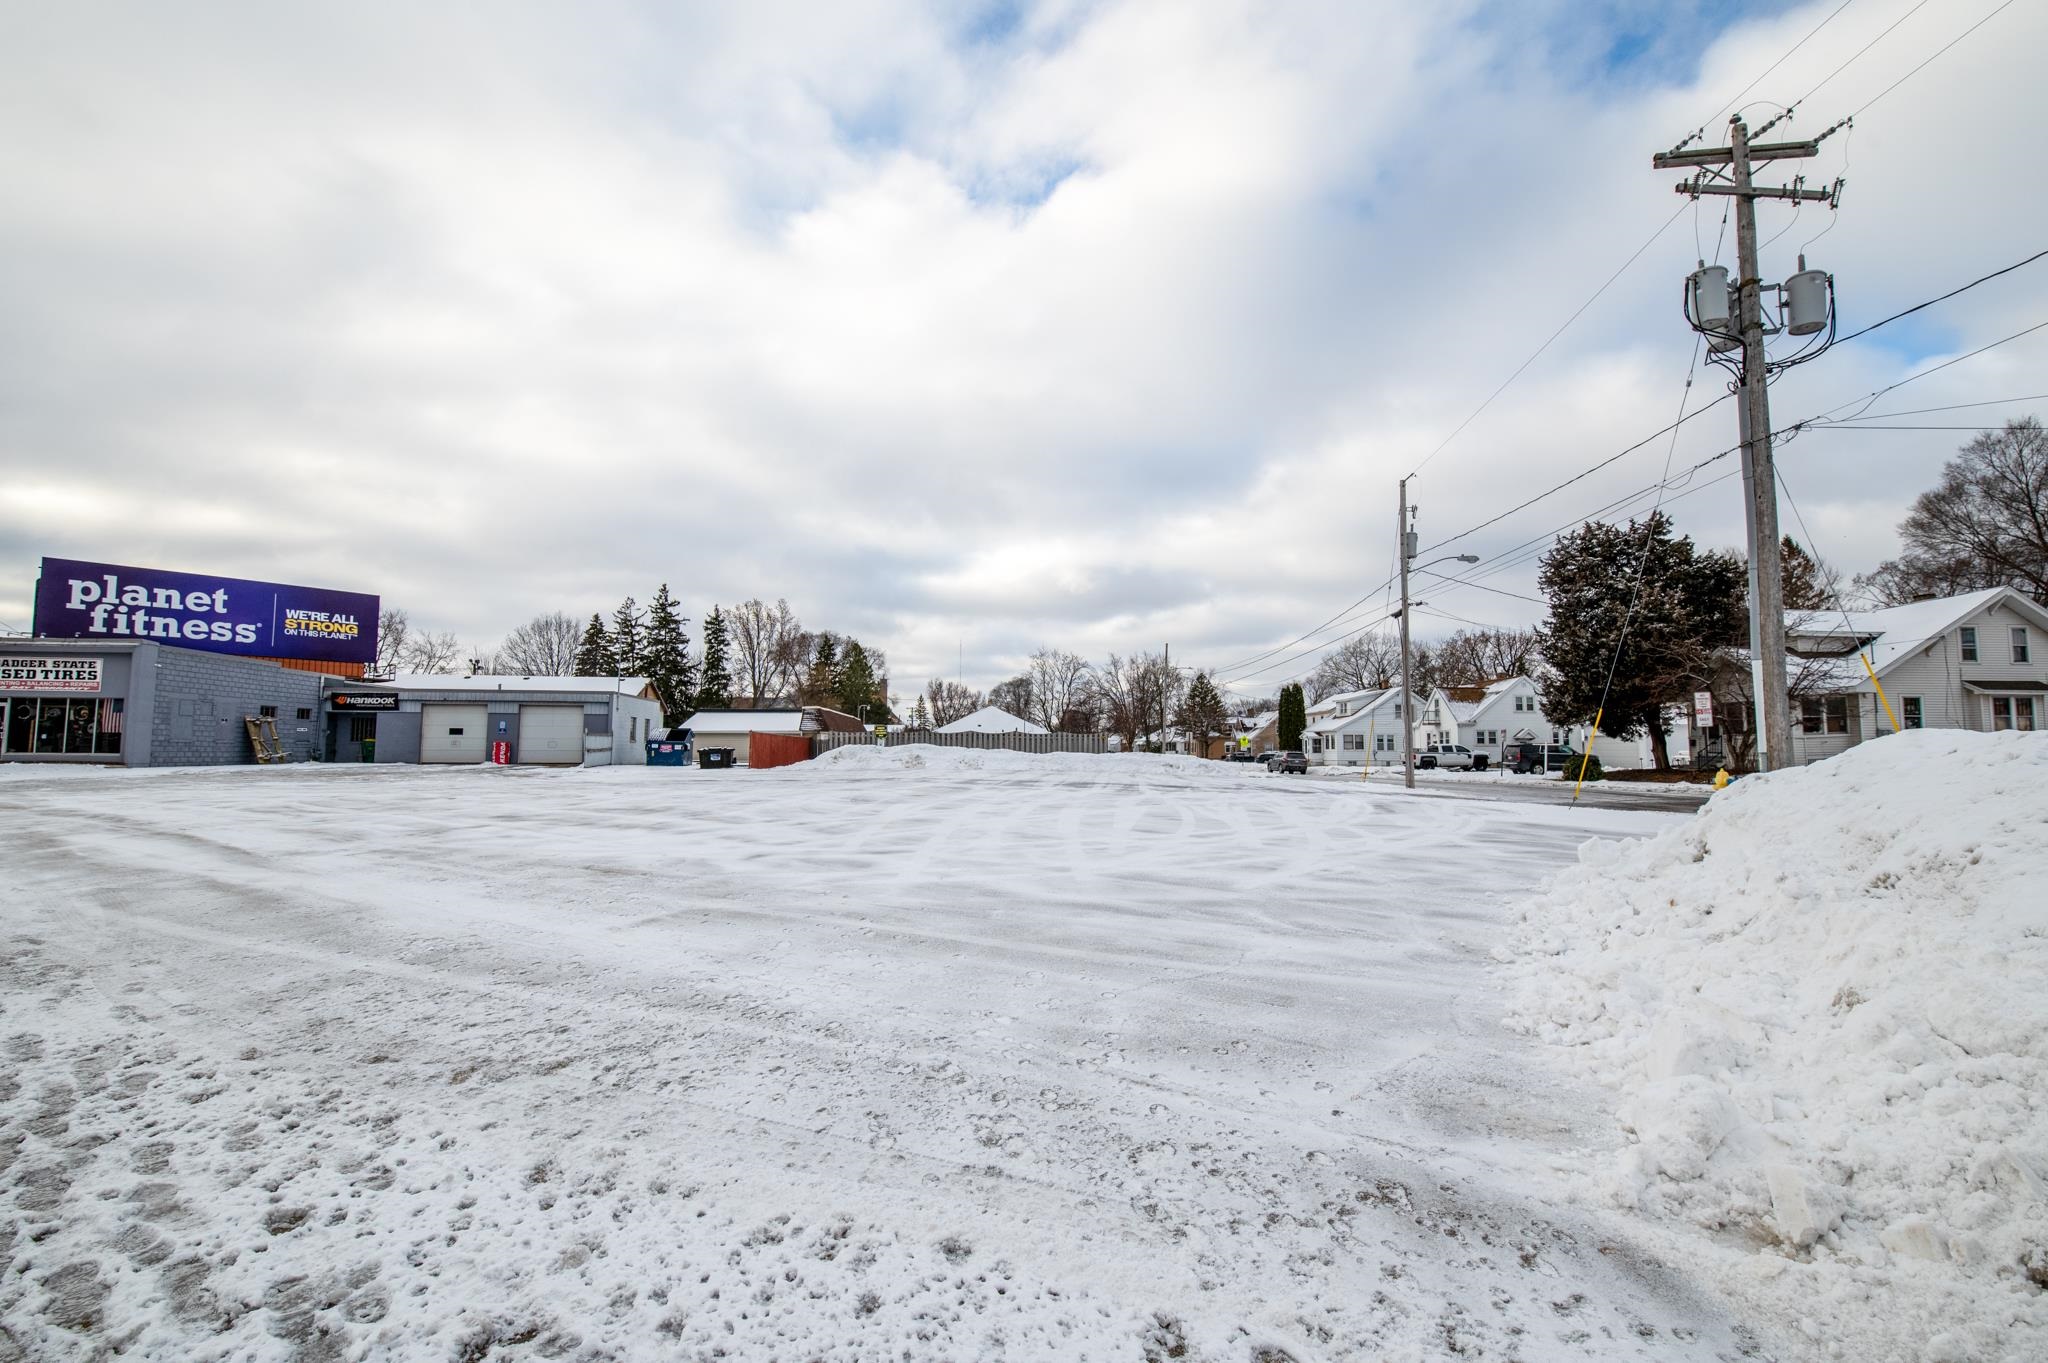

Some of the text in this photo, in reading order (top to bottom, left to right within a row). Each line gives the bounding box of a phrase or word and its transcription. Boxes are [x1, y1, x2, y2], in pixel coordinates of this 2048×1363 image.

[65, 574, 228, 614] planet
[88, 603, 257, 644] fitness
[286, 608, 359, 625] WE'RE ALL
[284, 618, 359, 634] STRONG
[284, 628, 298, 636] ON
[299, 629, 319, 638] THIS
[0, 659, 97, 669] ADGER STATE
[0, 668, 98, 681] SED TIRES
